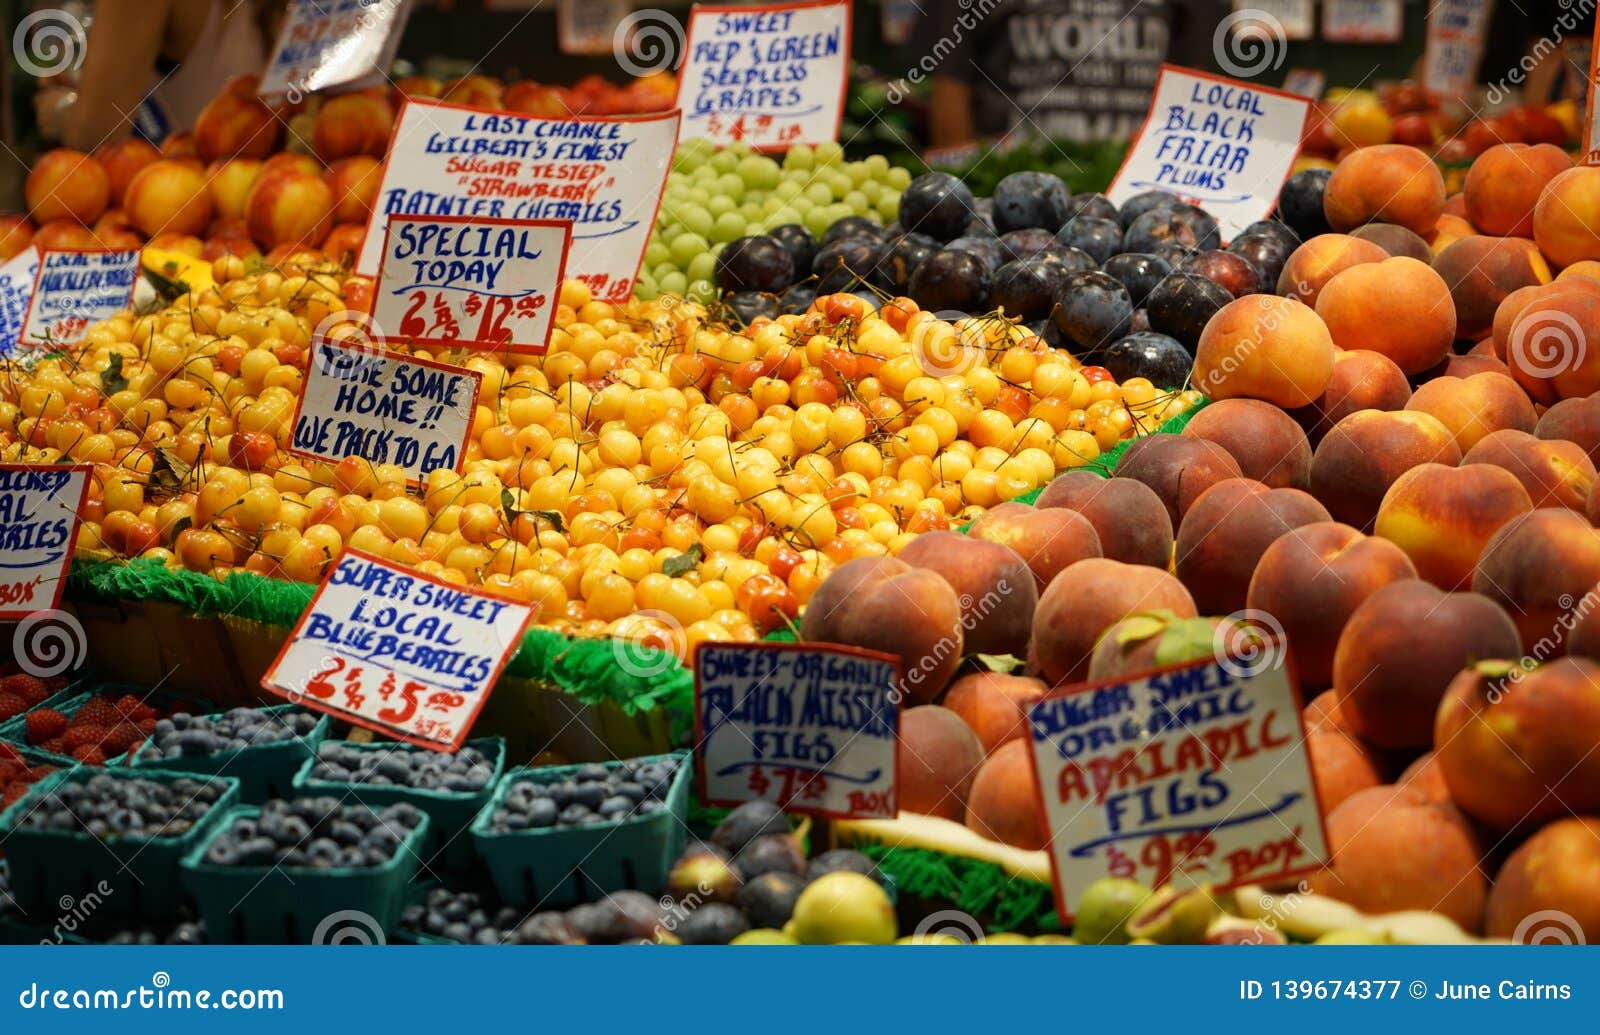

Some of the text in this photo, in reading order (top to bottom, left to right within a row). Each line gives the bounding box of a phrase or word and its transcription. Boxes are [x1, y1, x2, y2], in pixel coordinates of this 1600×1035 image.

[715, 11, 794, 35] SWEET
[694, 40, 741, 68] RED
[767, 25, 840, 62] GREEN
[701, 63, 807, 89] SEEDLESS
[695, 86, 801, 115] GRAPES
[1192, 82, 1265, 116] LOCAL
[464, 115, 621, 140] LAST CHANCE
[1162, 105, 1254, 143] BLACK
[425, 132, 635, 160] GILBERT'S FINEST
[1156, 135, 1250, 174] FRIAR
[446, 156, 605, 181] SUGAR TESTED
[1156, 164, 1227, 192] PLUMS
[513, 200, 622, 223] CHERRIES
[394, 223, 543, 260] SPECIAL
[412, 258, 505, 291] TODAY
[399, 290, 427, 337] 2
[319, 345, 463, 407] TAKE SOME
[294, 416, 456, 474] WE PACK TO GO
[329, 558, 510, 624] SUPER SWEET
[350, 599, 461, 646] LOCAL
[304, 612, 493, 683] BLUEBERRIES
[304, 657, 346, 698] 2
[701, 681, 796, 735] BLACK
[1031, 655, 1252, 742] SUGAR SWEET
[1058, 689, 1253, 759] ORGANIC
[752, 731, 836, 764] FIGS
[846, 787, 895, 816] BOX
[1105, 768, 1230, 832] FIGS
[1223, 825, 1303, 881] BOX
